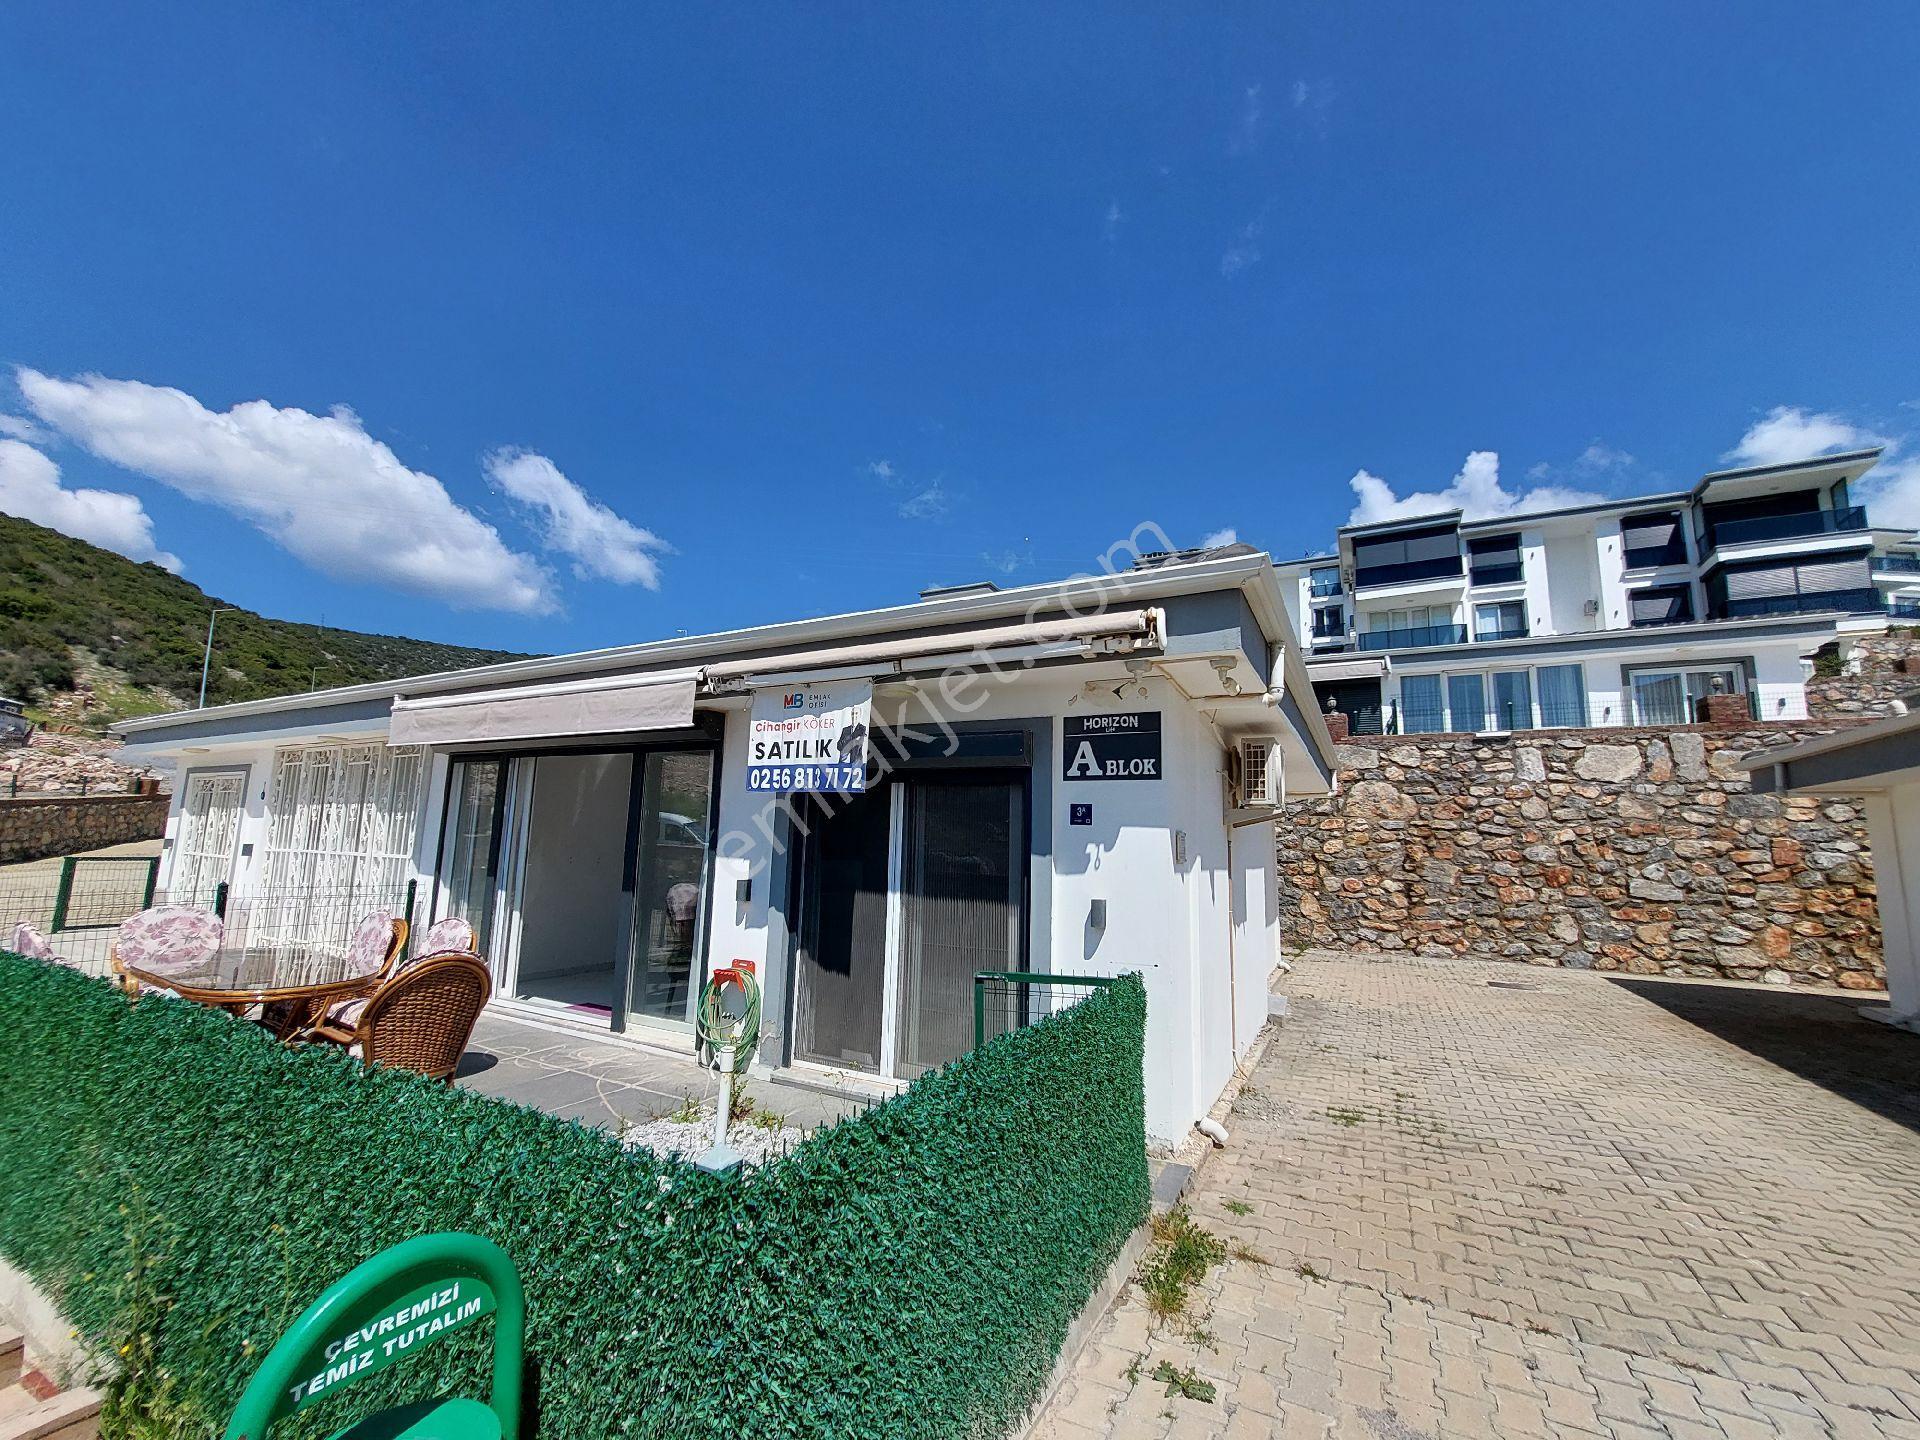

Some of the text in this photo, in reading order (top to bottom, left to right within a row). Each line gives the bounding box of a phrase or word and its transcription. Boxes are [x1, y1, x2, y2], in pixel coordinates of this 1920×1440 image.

[783, 693, 804, 709] MB
[1083, 715, 1139, 731] HORIZON
[755, 739, 833, 760] SATILIK
[1066, 740, 1157, 777] A BLOK
[750, 767, 863, 789] 0256 813 71 72
[324, 1281, 460, 1364] ÇEVREMİZİ
[289, 1297, 482, 1403] TEMİZ TUTALIM
